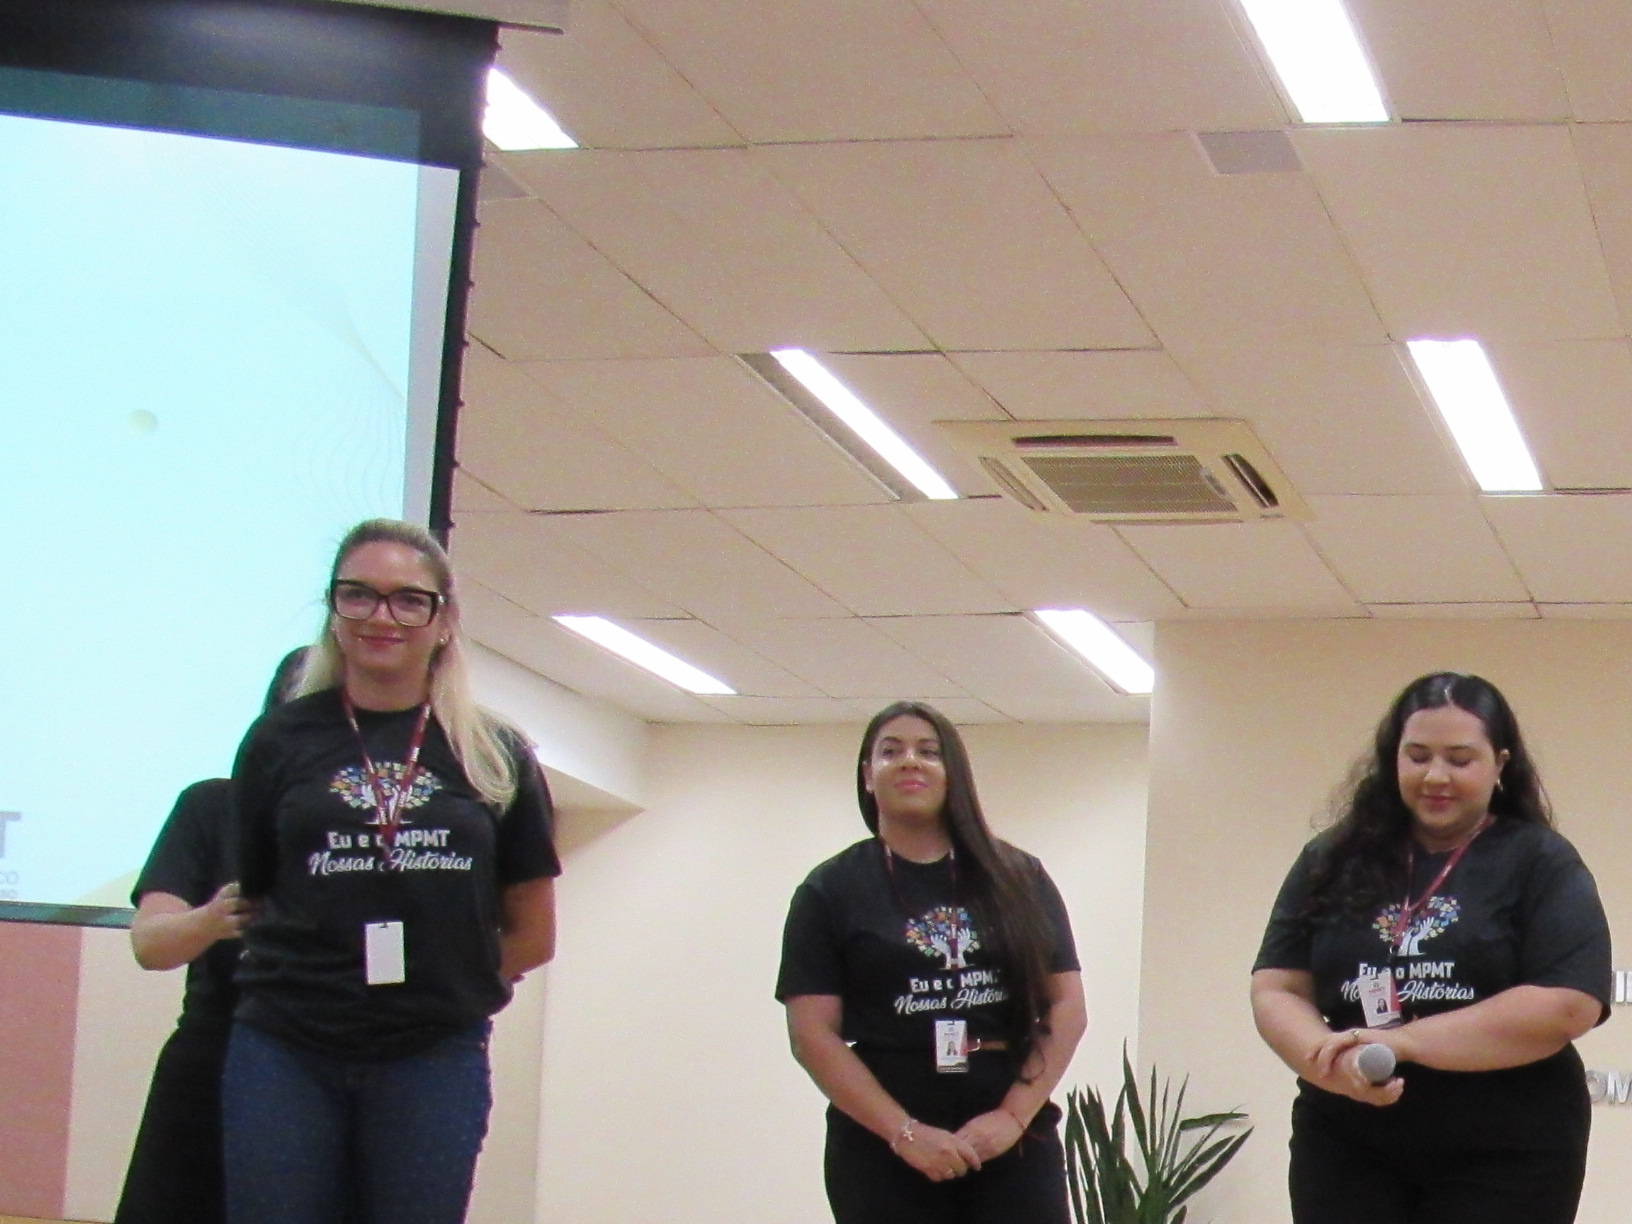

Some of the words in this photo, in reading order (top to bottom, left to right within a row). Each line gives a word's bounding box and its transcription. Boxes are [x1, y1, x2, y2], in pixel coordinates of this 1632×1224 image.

[327, 831, 351, 849] Eu
[358, 834, 369, 848] e
[394, 829, 450, 847] MPMT
[308, 851, 375, 876] Nossas
[909, 978, 930, 993] Eu
[934, 979, 944, 991] e
[960, 969, 1000, 988] MPM
[1396, 967, 1405, 979] o
[1409, 962, 1455, 979] MPMT
[894, 993, 948, 1015] Nossas
